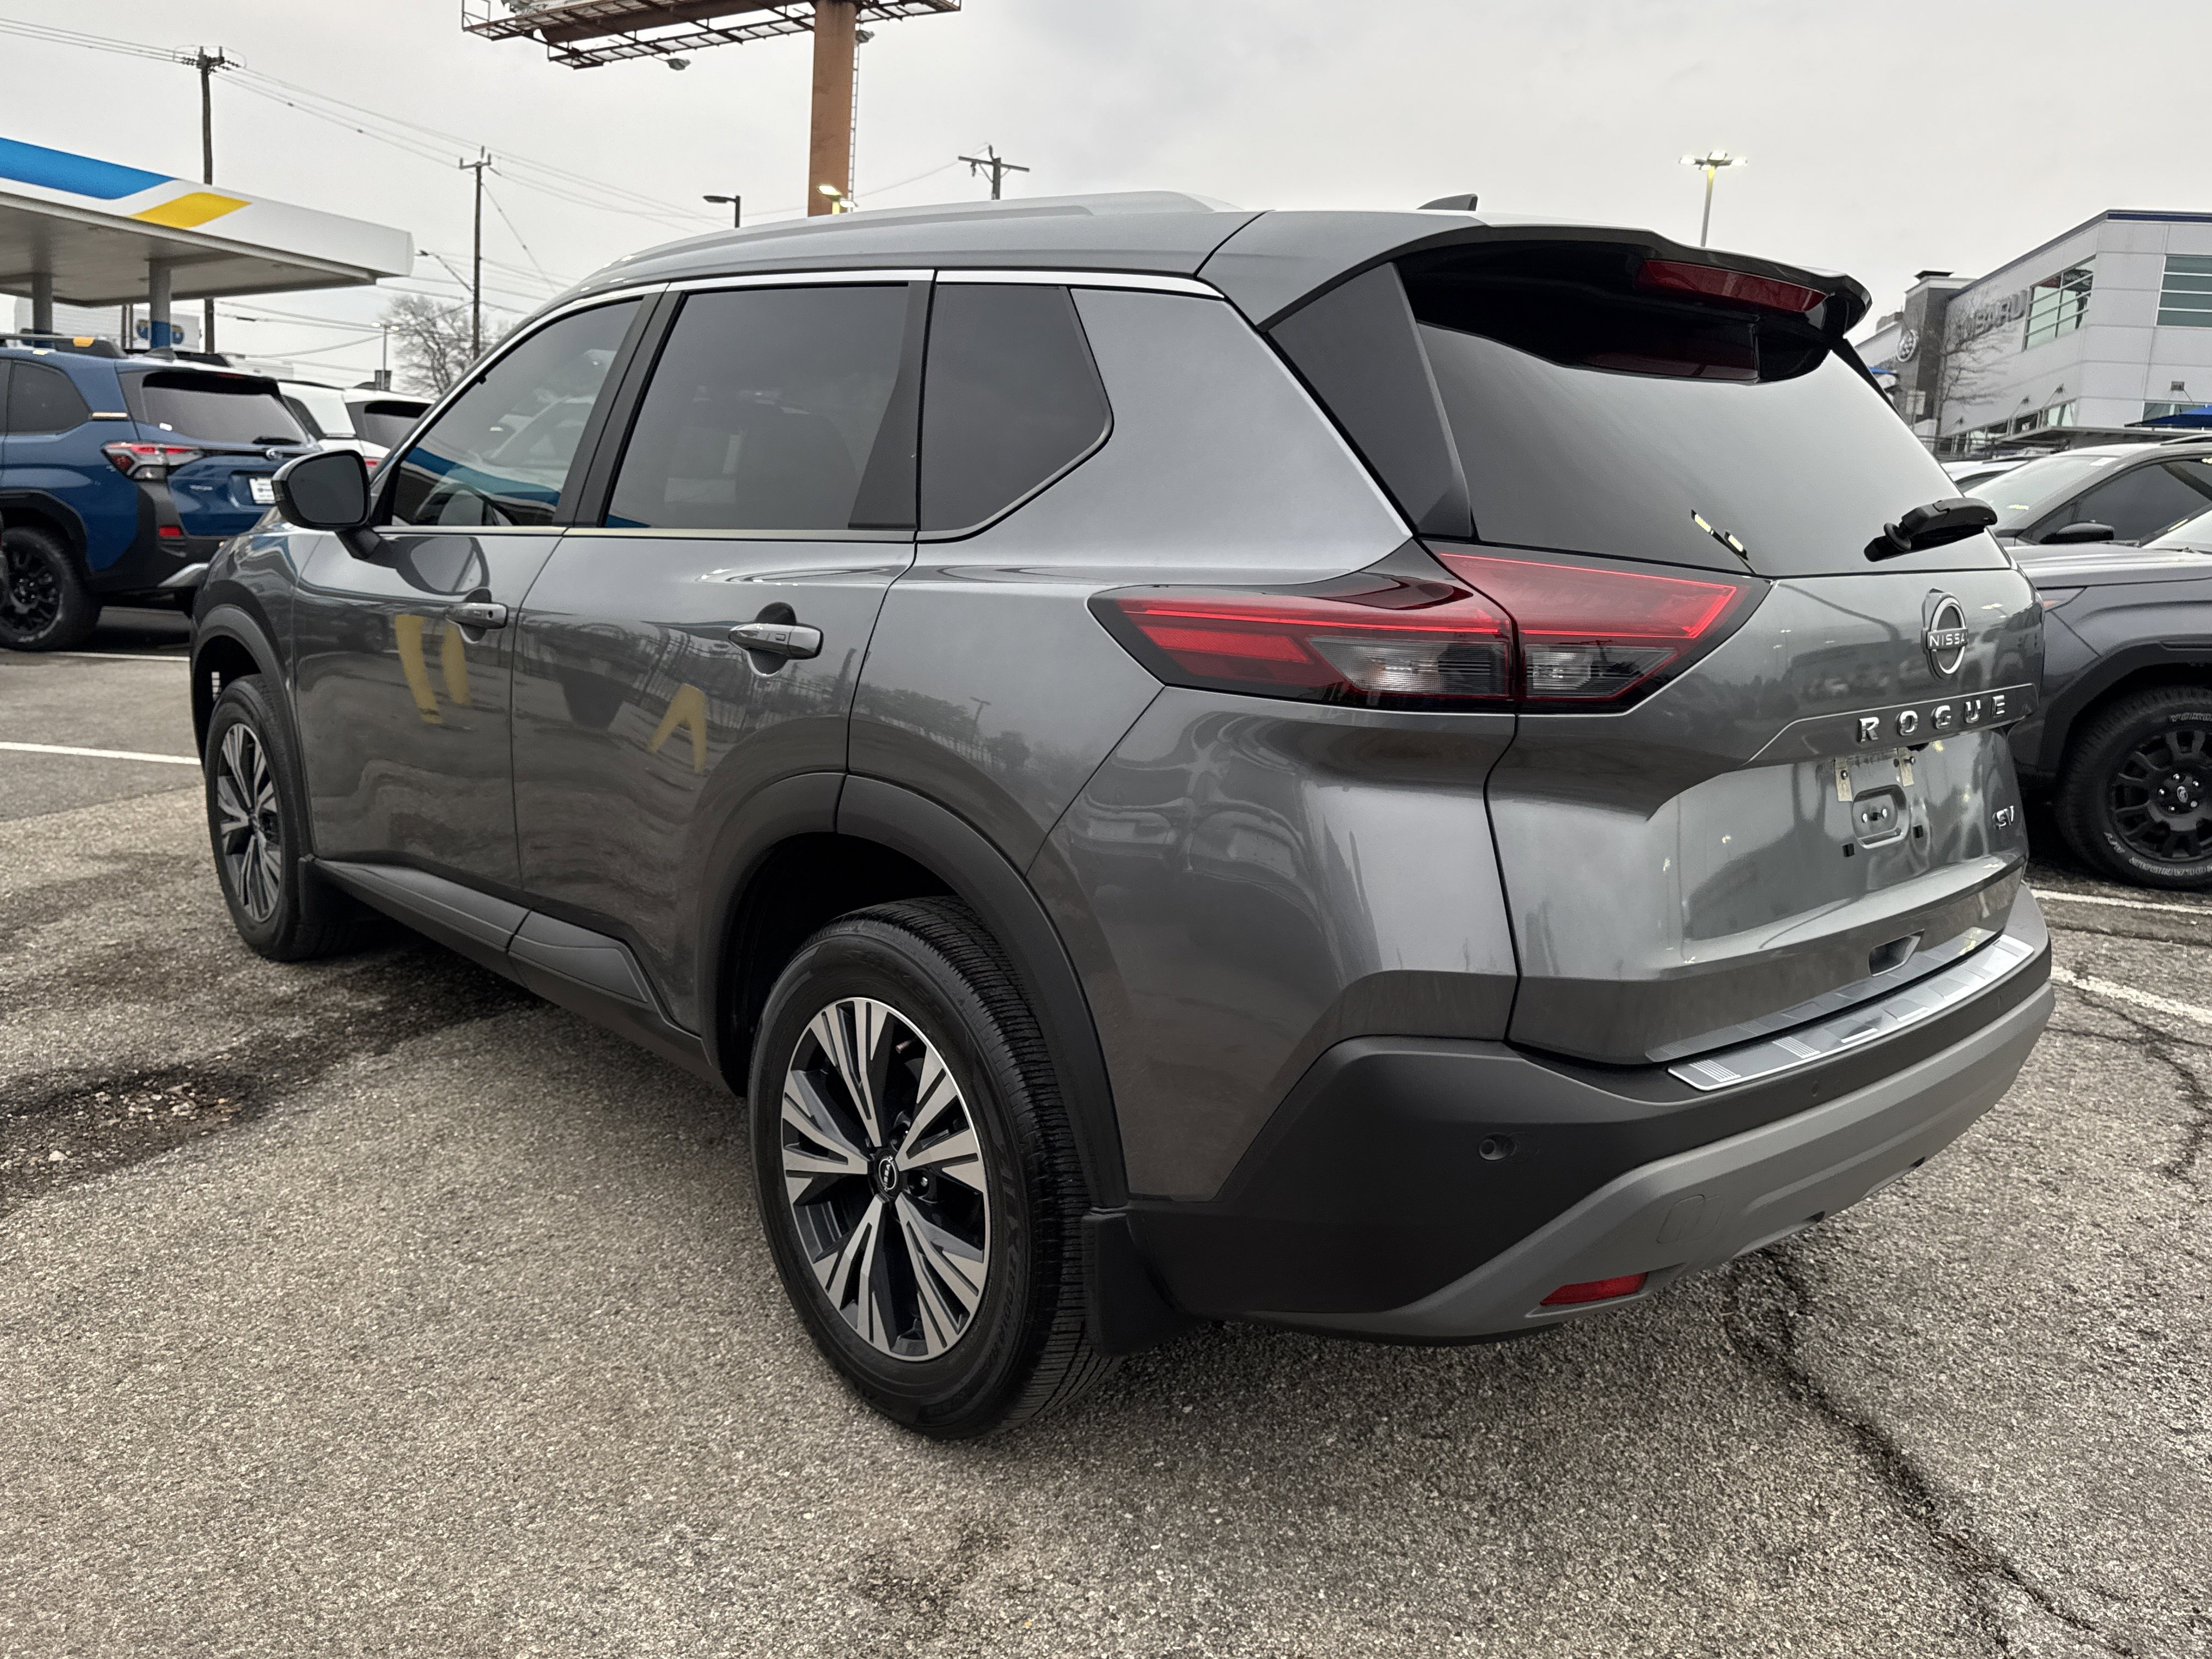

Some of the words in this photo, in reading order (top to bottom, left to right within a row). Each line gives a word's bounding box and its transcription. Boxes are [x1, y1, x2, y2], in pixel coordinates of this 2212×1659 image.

[1929, 632, 1968, 647] NISSA
[1858, 695, 2006, 742] ROGUE
[1994, 805, 2015, 830] SV
